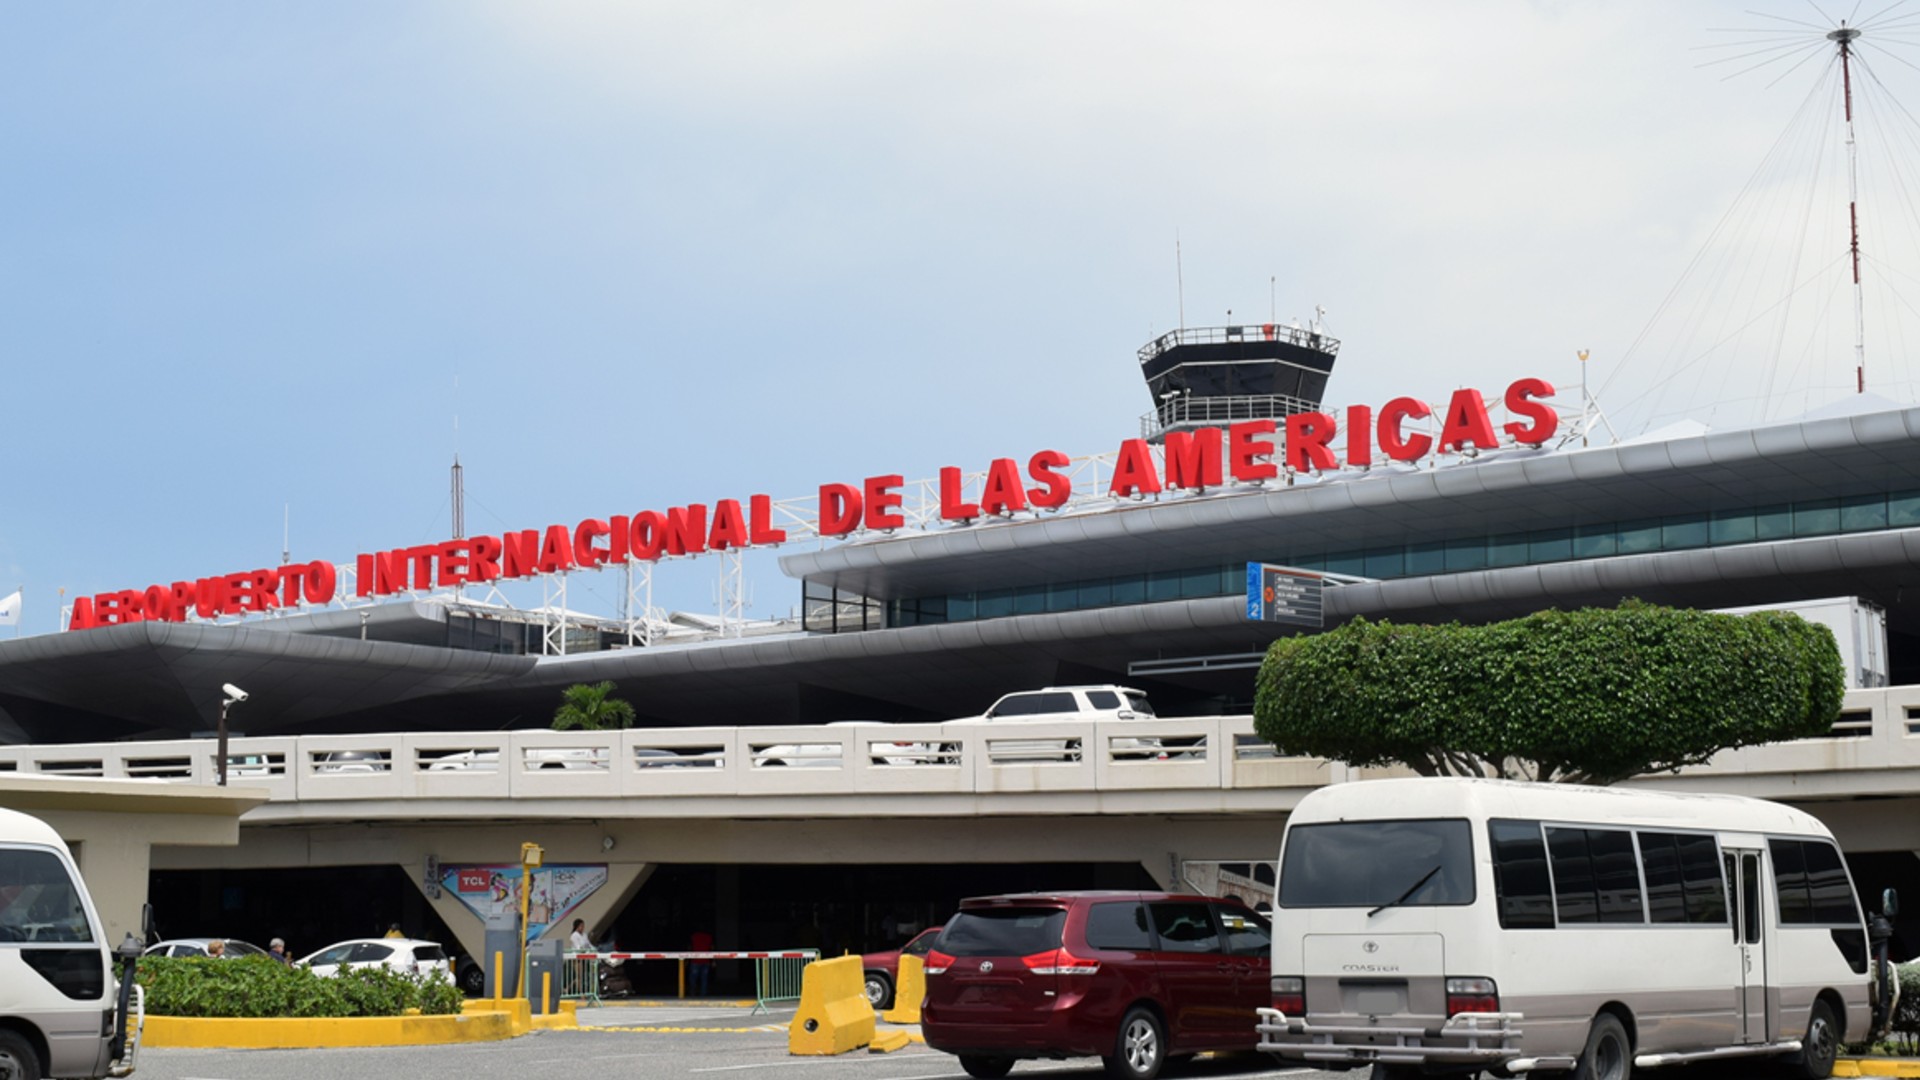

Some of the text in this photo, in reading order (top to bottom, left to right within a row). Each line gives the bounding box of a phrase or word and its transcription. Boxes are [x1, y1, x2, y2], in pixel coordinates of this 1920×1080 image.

[69, 377, 1559, 631] AEROPUERTO INTERNACIONAL DE LAS AMERICAS
[1250, 602, 1260, 617] 2
[462, 876, 486, 887] TCL
[1342, 964, 1400, 972] COASTER
